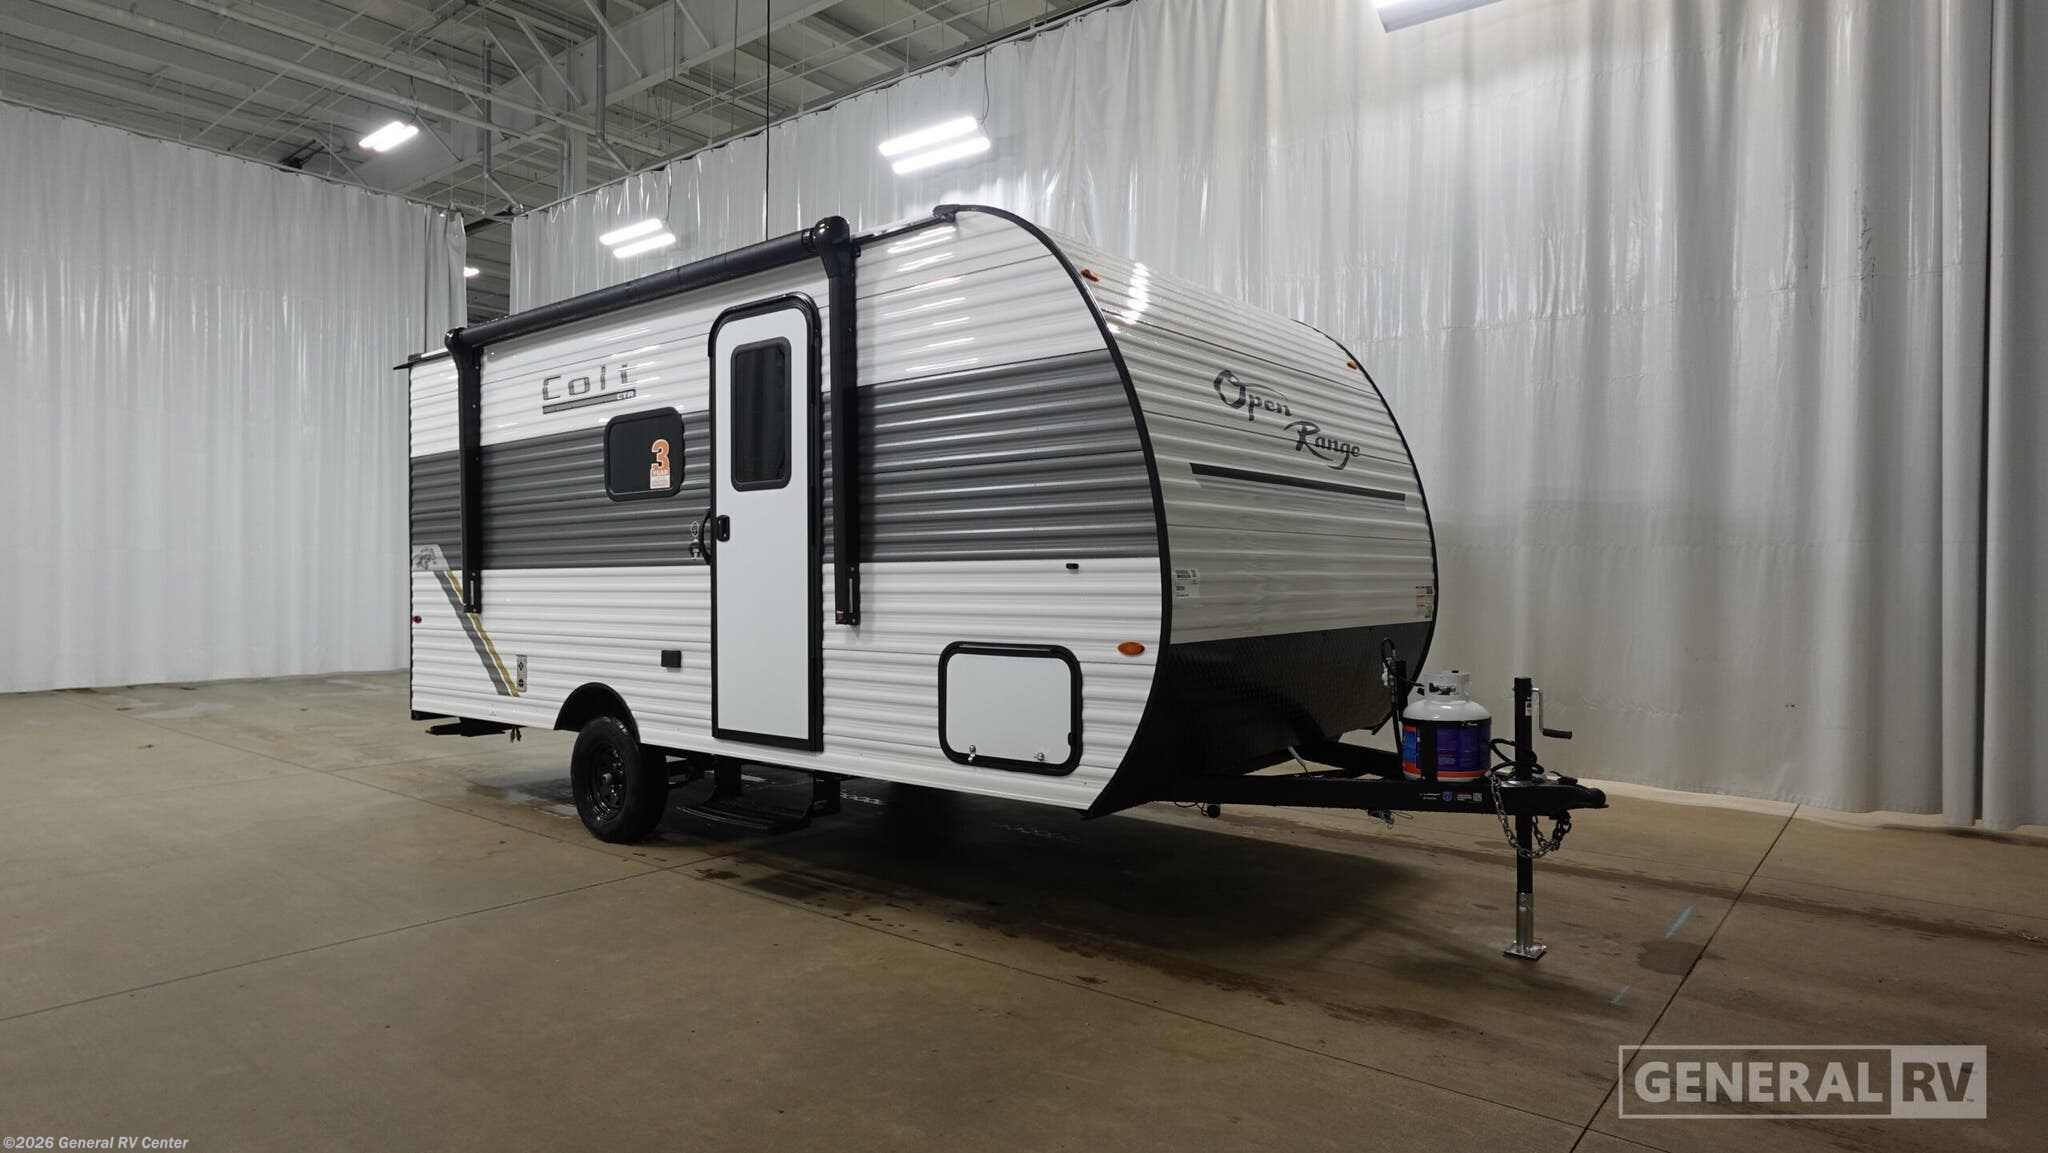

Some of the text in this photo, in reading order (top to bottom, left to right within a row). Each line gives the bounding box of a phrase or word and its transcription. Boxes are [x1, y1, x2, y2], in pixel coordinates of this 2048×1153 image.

[1213, 369, 1292, 421] Open
[652, 439, 669, 470] 3
[1284, 420, 1360, 470] Range
